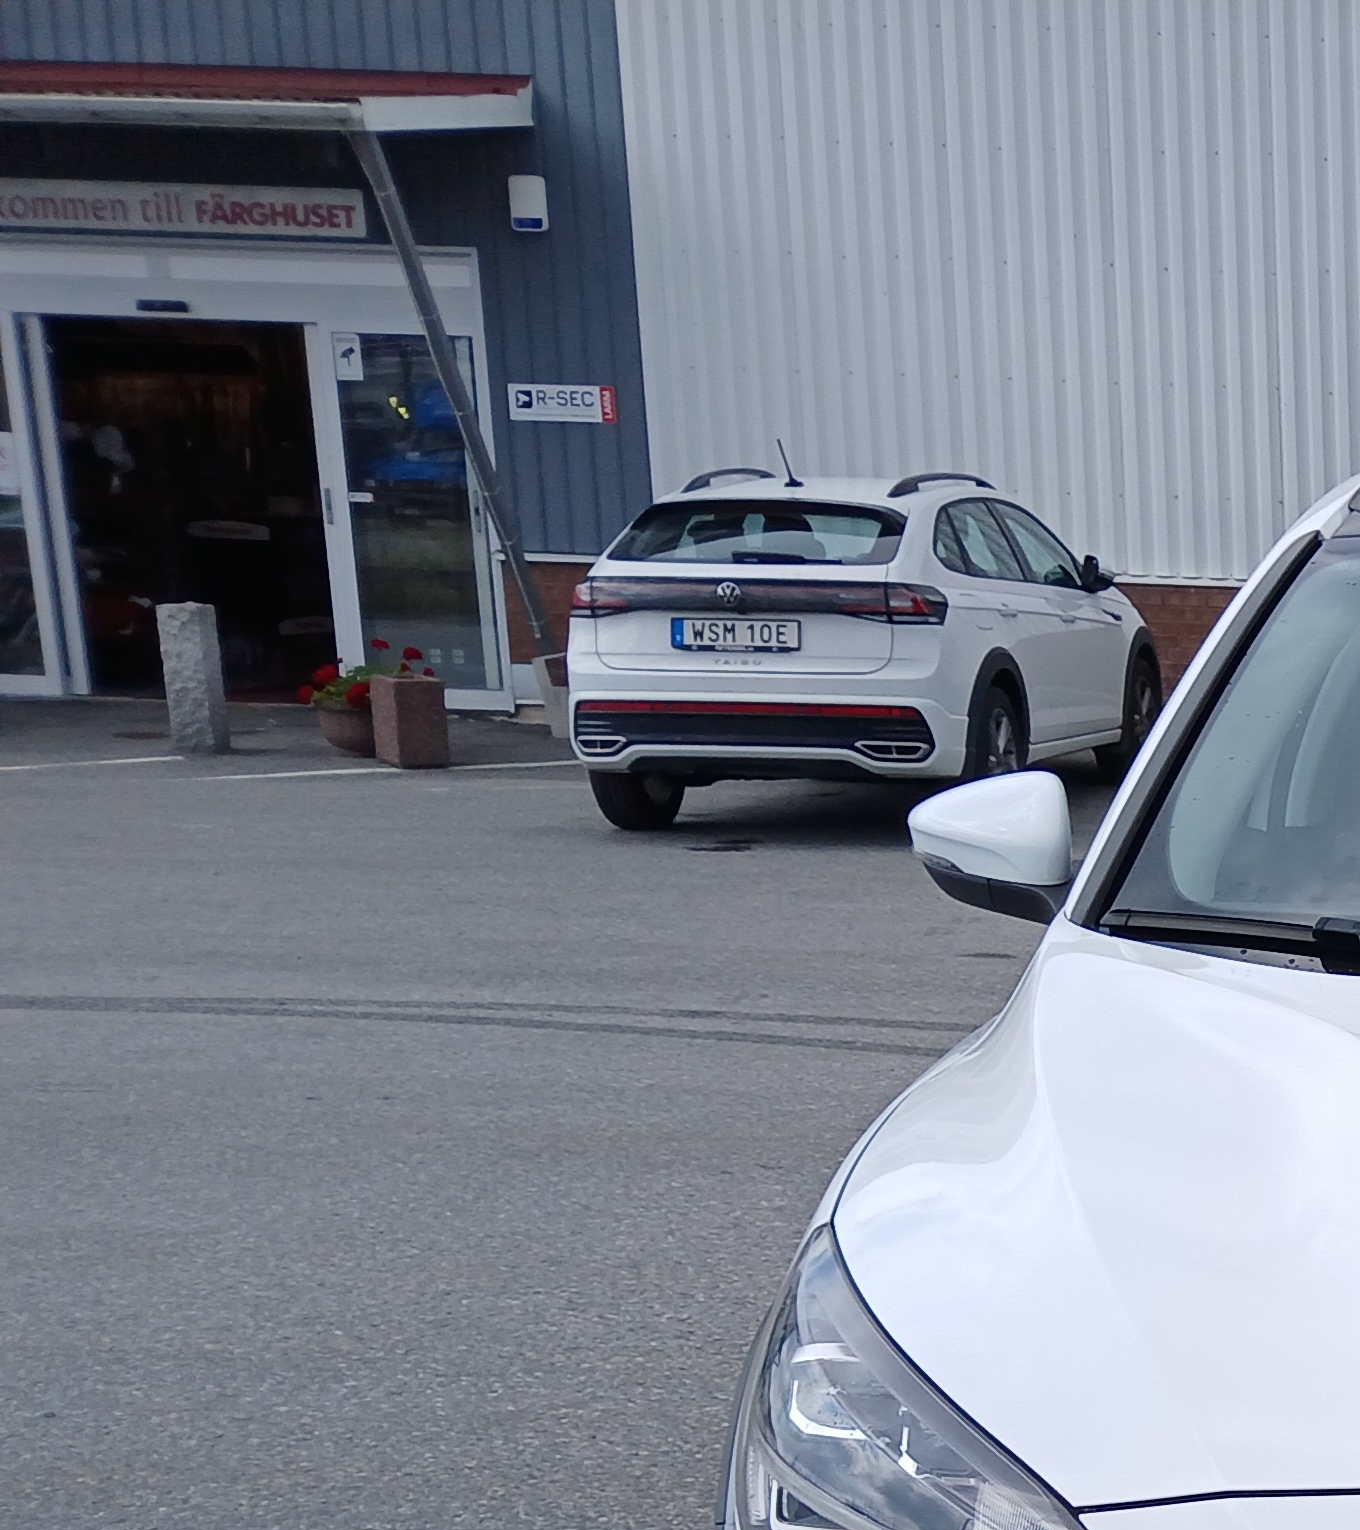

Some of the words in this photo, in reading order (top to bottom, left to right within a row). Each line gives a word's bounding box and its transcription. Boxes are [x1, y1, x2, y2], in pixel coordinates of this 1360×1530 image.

[140, 191, 183, 224] till
[536, 389, 595, 408] R-SEC
[691, 622, 737, 643] WSM
[746, 623, 788, 645] 10E
